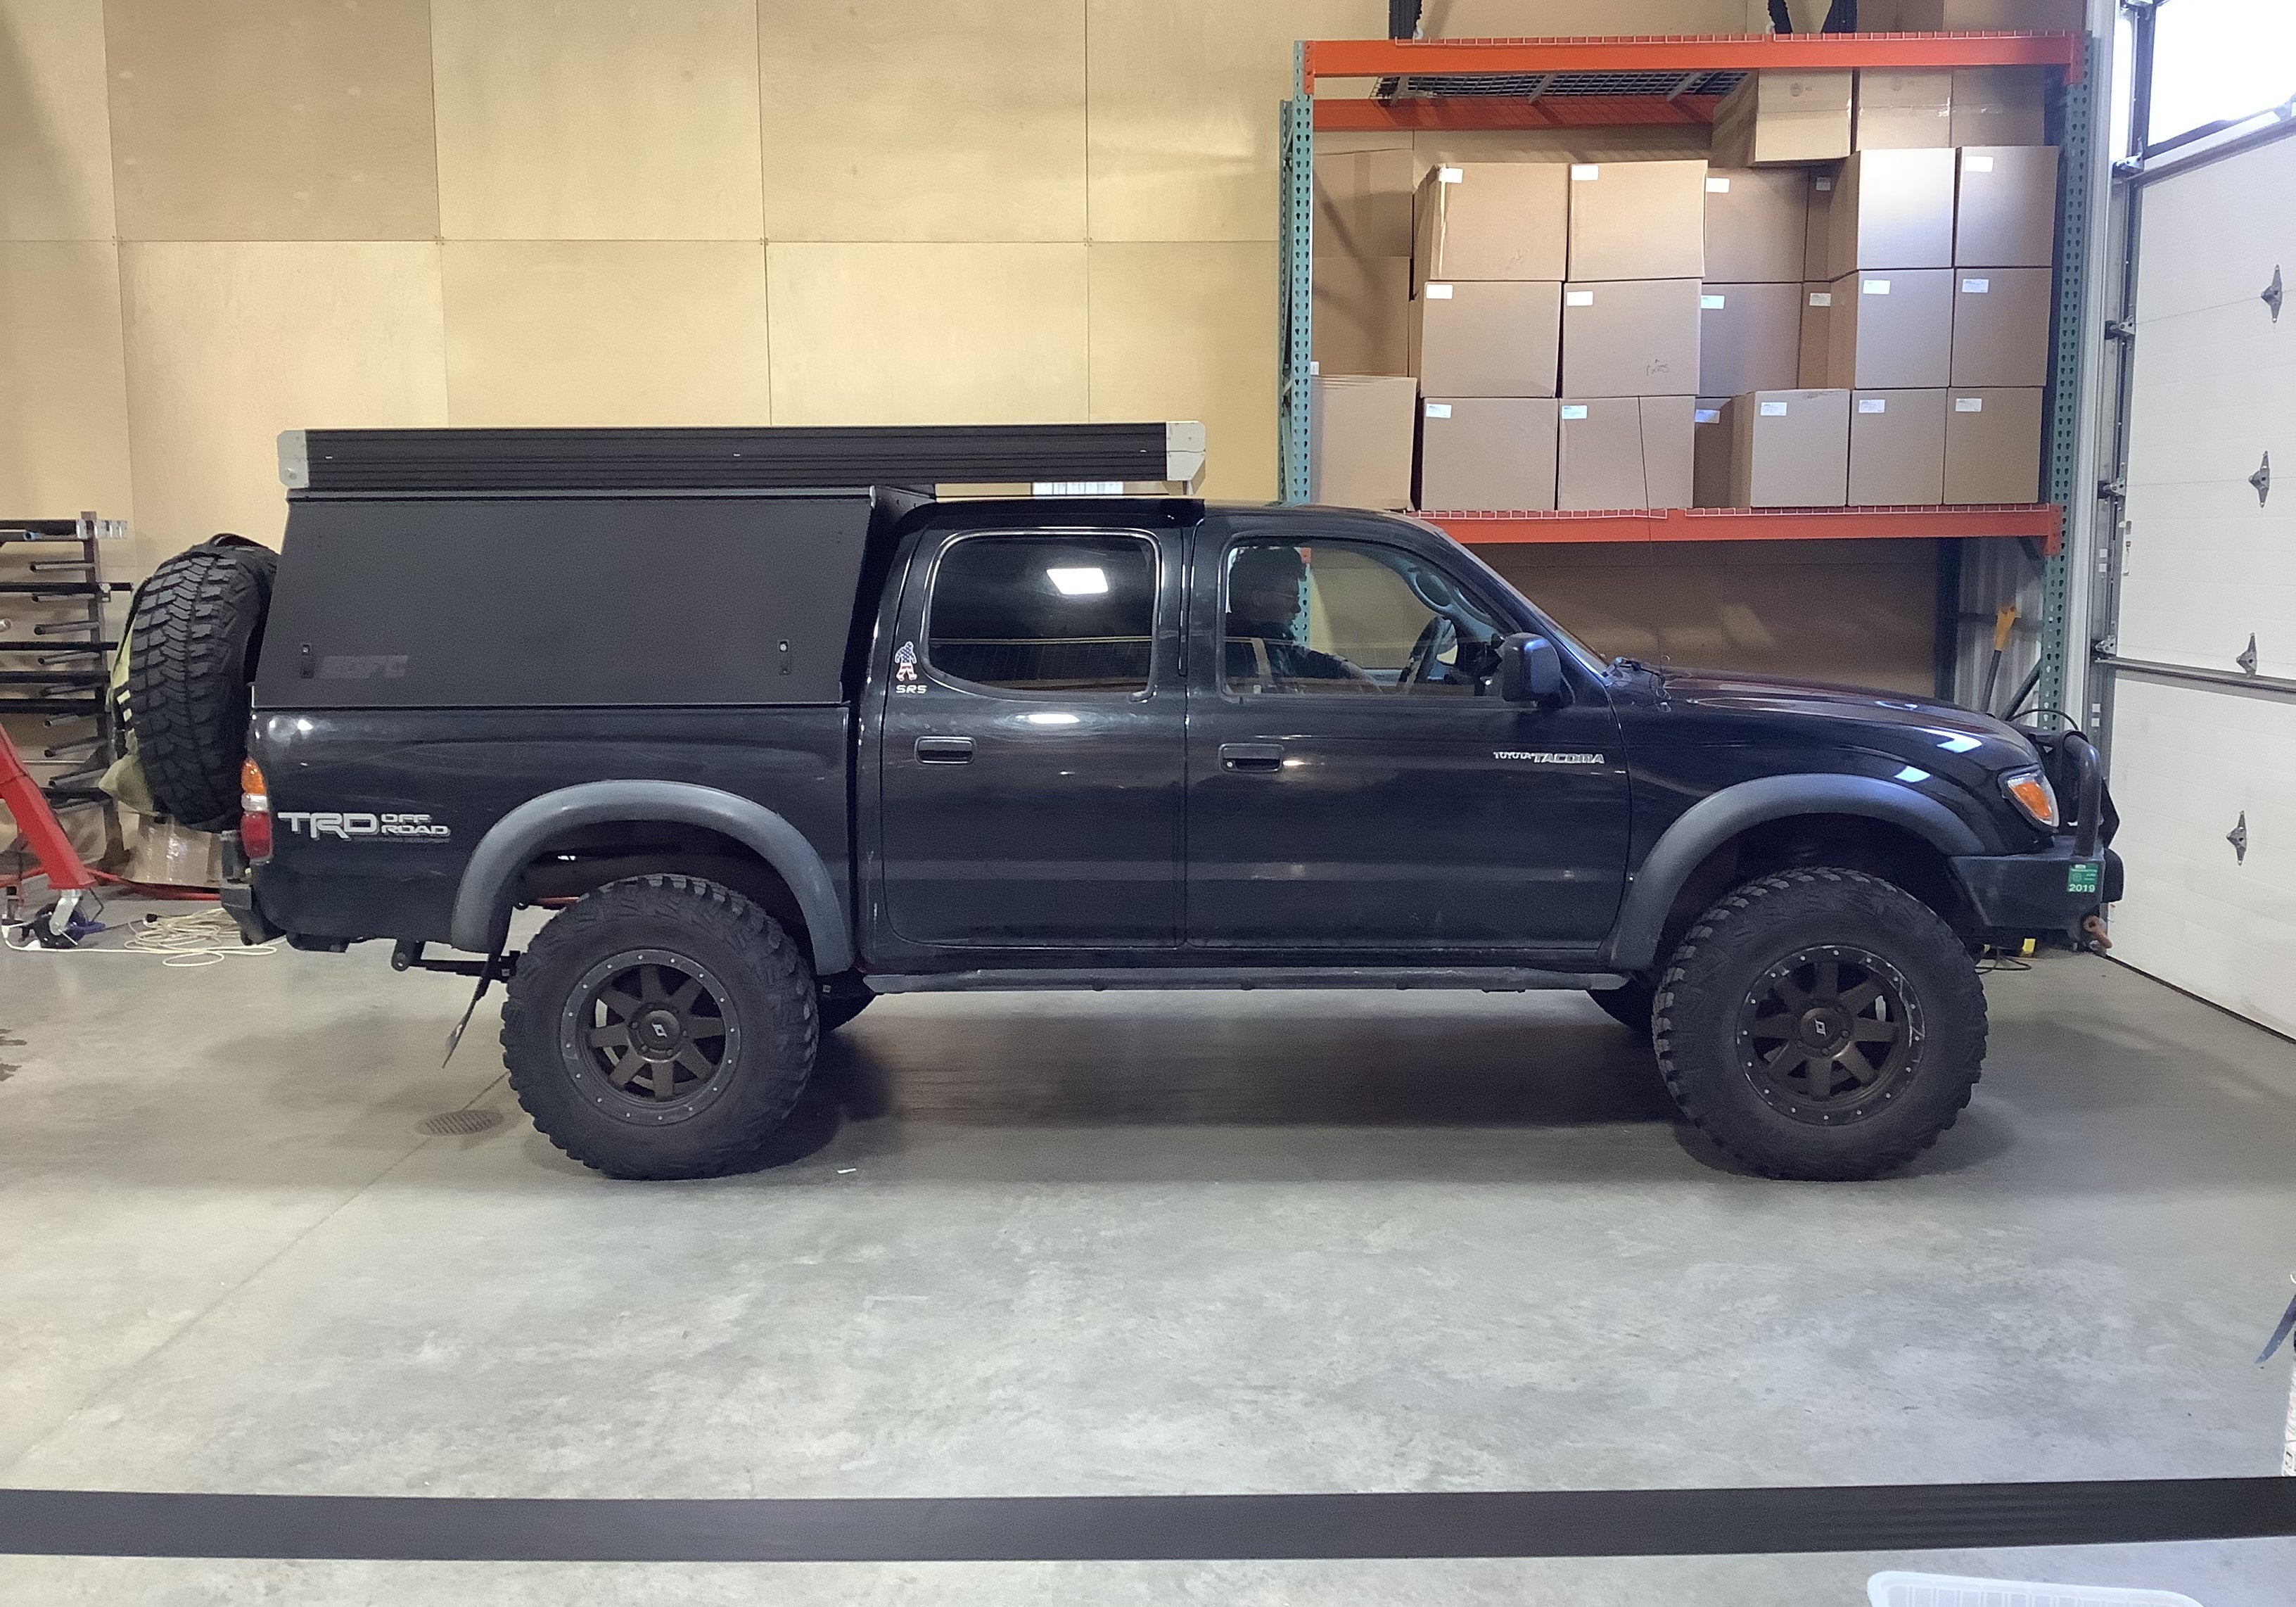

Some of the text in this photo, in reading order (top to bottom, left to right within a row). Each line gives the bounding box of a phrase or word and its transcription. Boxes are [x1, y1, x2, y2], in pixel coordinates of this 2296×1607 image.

[1531, 753, 1605, 764] TACOMA
[277, 812, 432, 840] TRD OFF
[381, 825, 450, 836] ROAD
[2069, 884, 2096, 892] 2019
